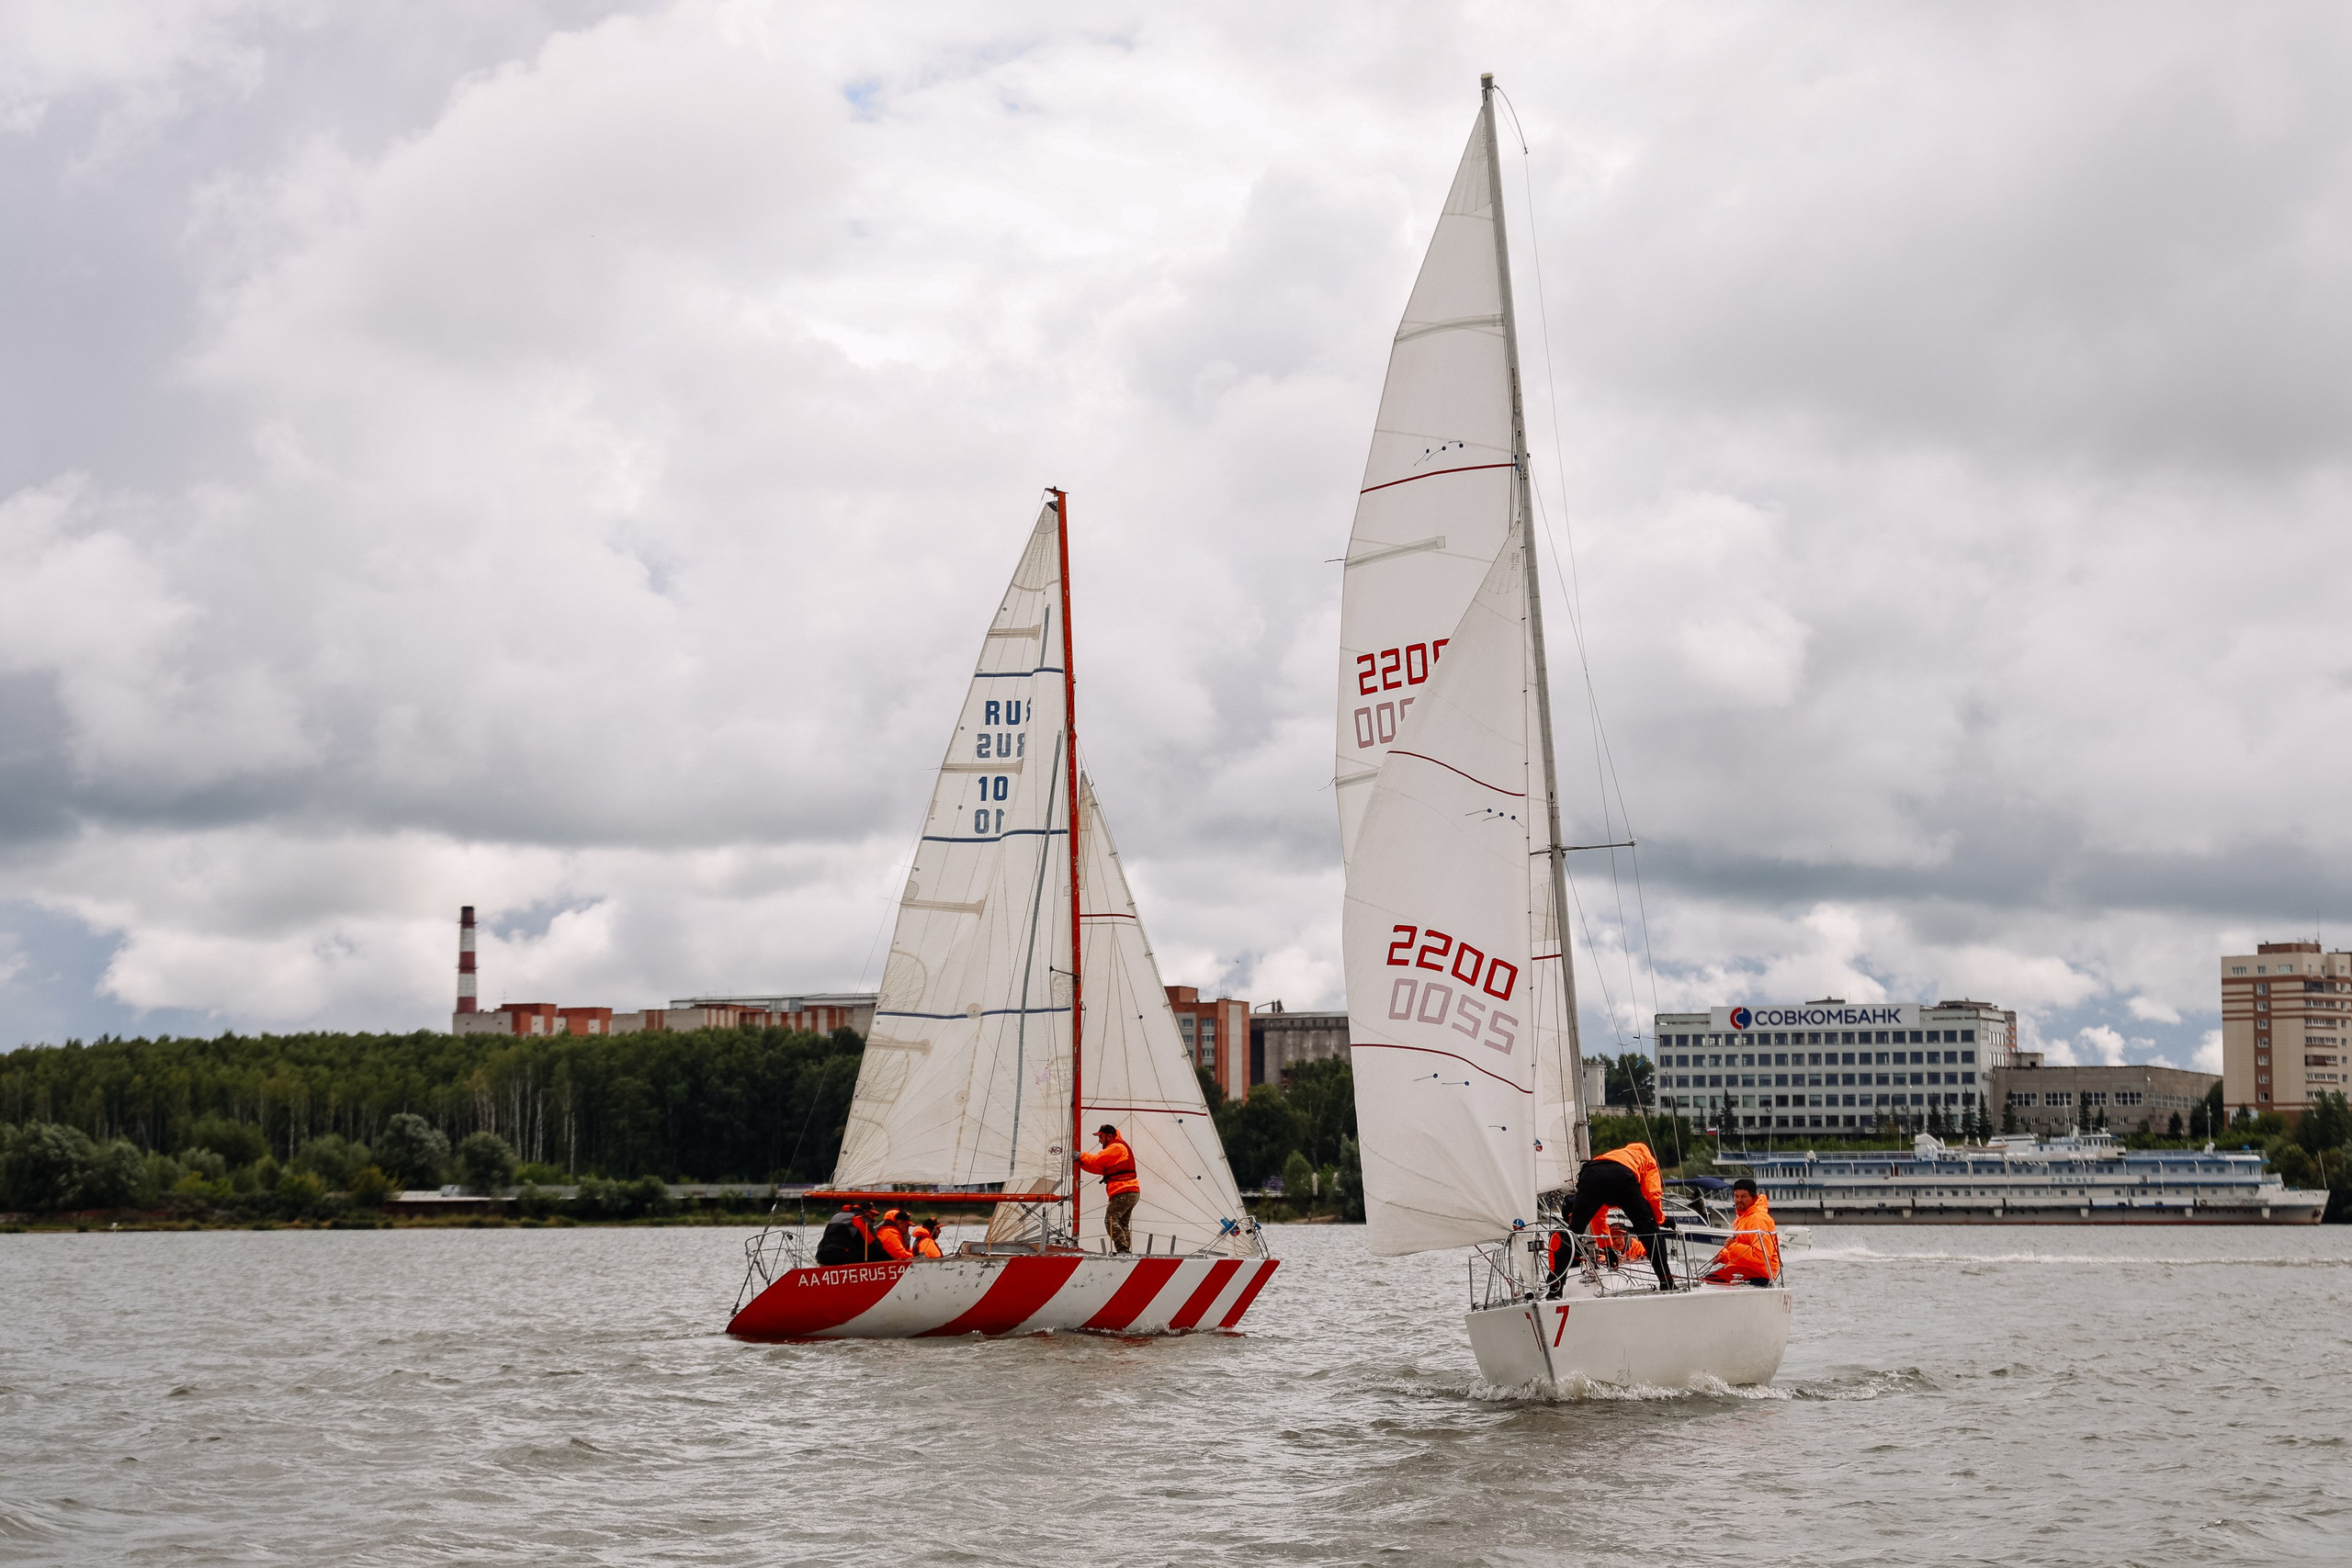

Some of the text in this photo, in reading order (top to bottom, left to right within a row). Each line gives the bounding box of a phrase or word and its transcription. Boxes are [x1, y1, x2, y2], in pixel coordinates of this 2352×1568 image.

[978, 775, 1009, 802] 10
[1386, 924, 1519, 1001] 2200
[1755, 1008, 1902, 1027] СОВКОМБАНК
[1711, 1237, 1724, 1246] YAMA
[1553, 1304, 1570, 1348] 7
